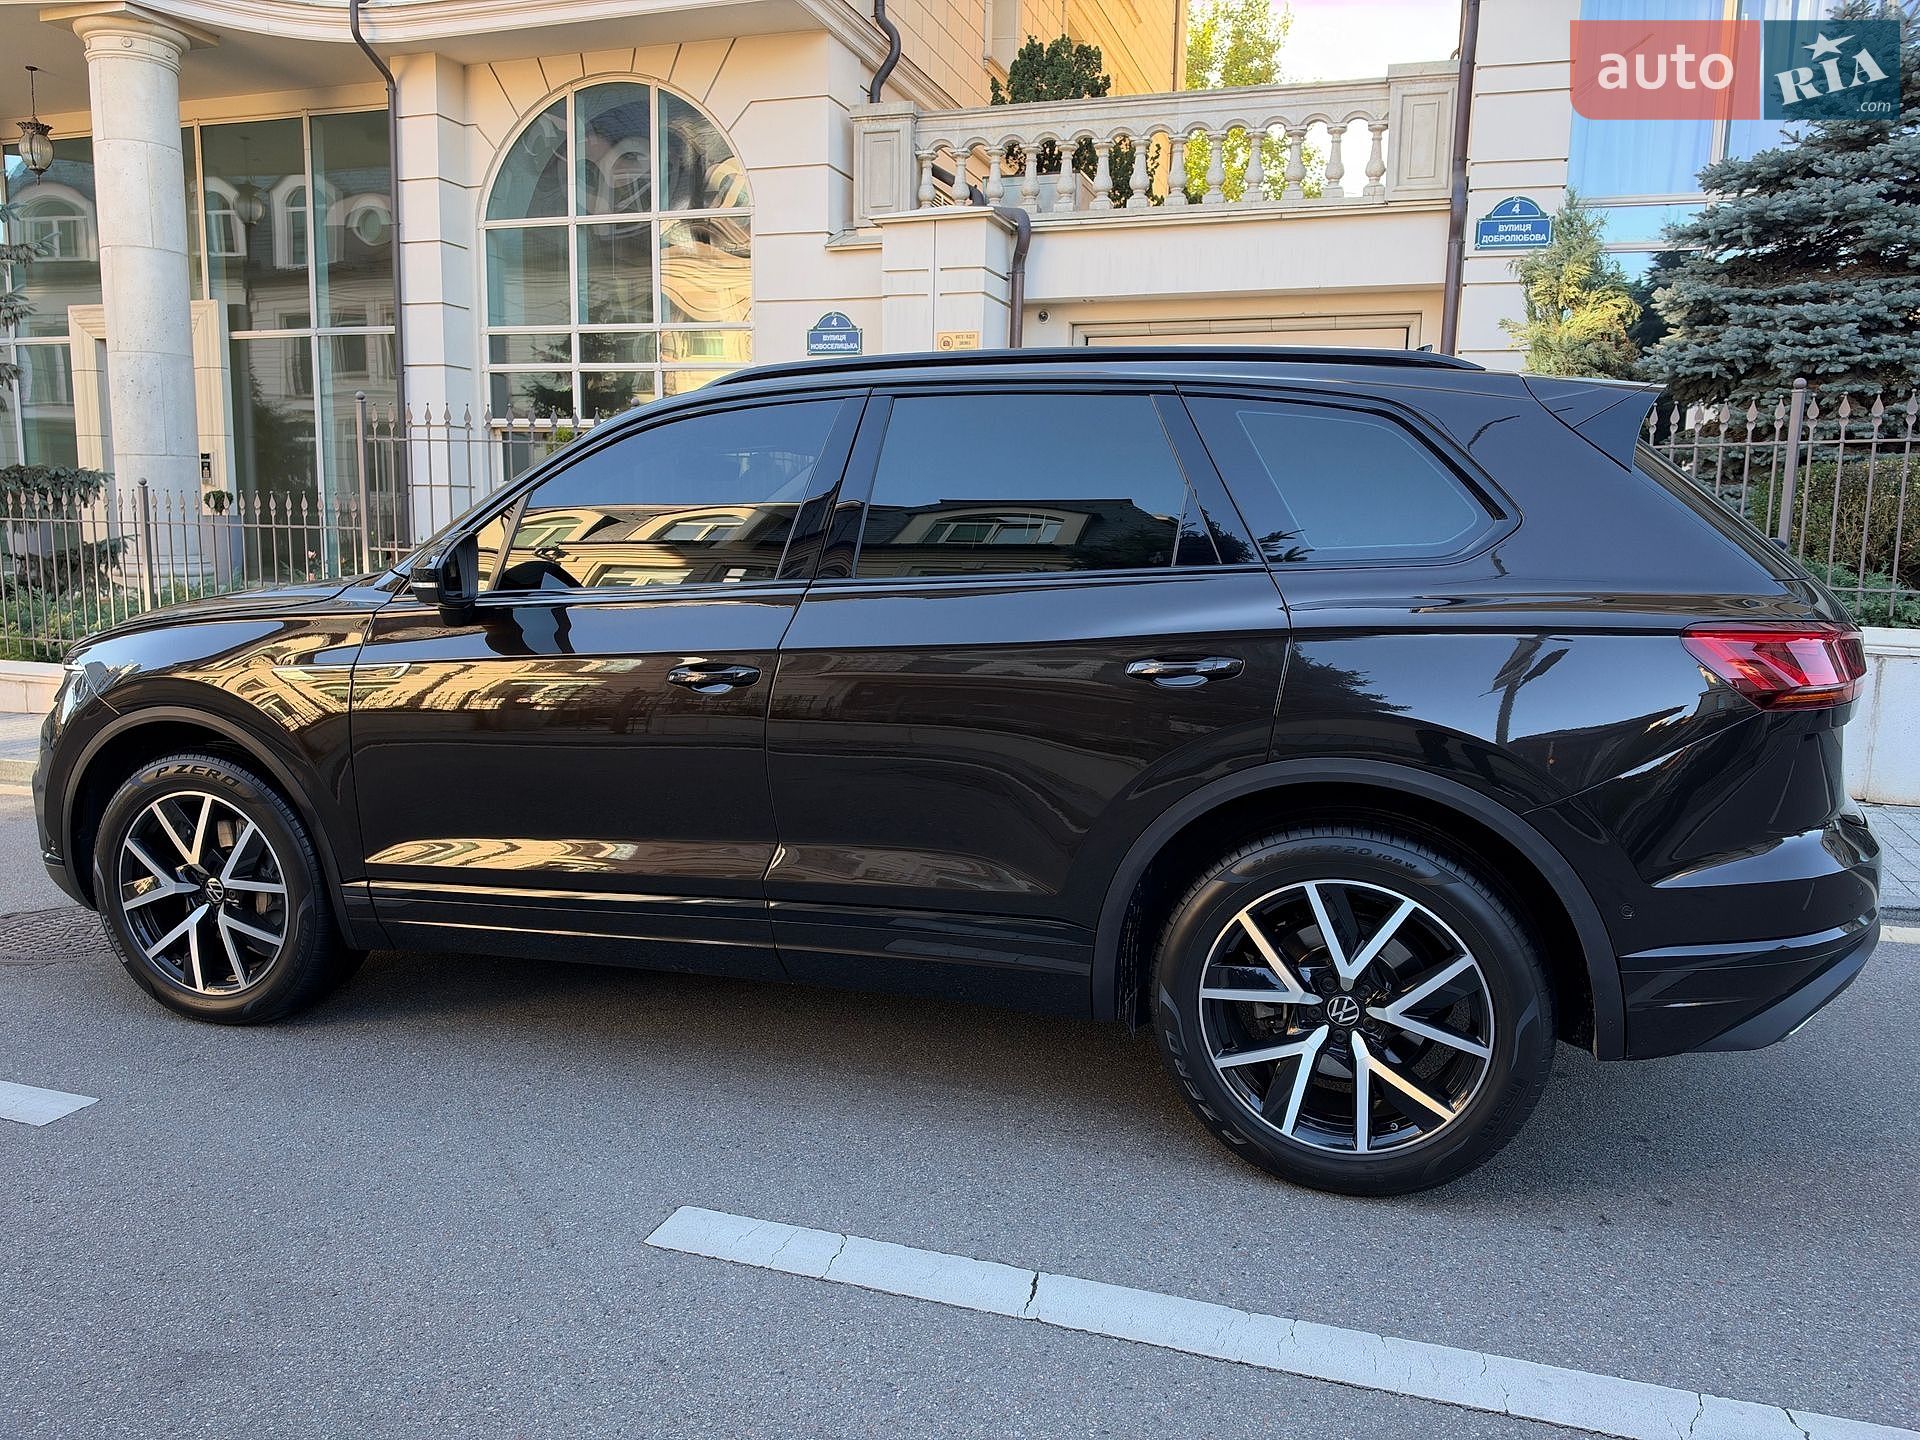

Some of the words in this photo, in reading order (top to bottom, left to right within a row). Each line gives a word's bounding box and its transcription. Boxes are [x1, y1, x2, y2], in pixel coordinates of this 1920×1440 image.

[1511, 203, 1521, 214] 4
[1498, 223, 1532, 233] ВУЛИЦЯ
[1481, 233, 1547, 244] ДОБРОЛЮБОВА
[831, 317, 839, 327] 4
[822, 334, 847, 342] ВУЛИЦЯ
[155, 765, 170, 779] P
[173, 764, 241, 787] ZERO
